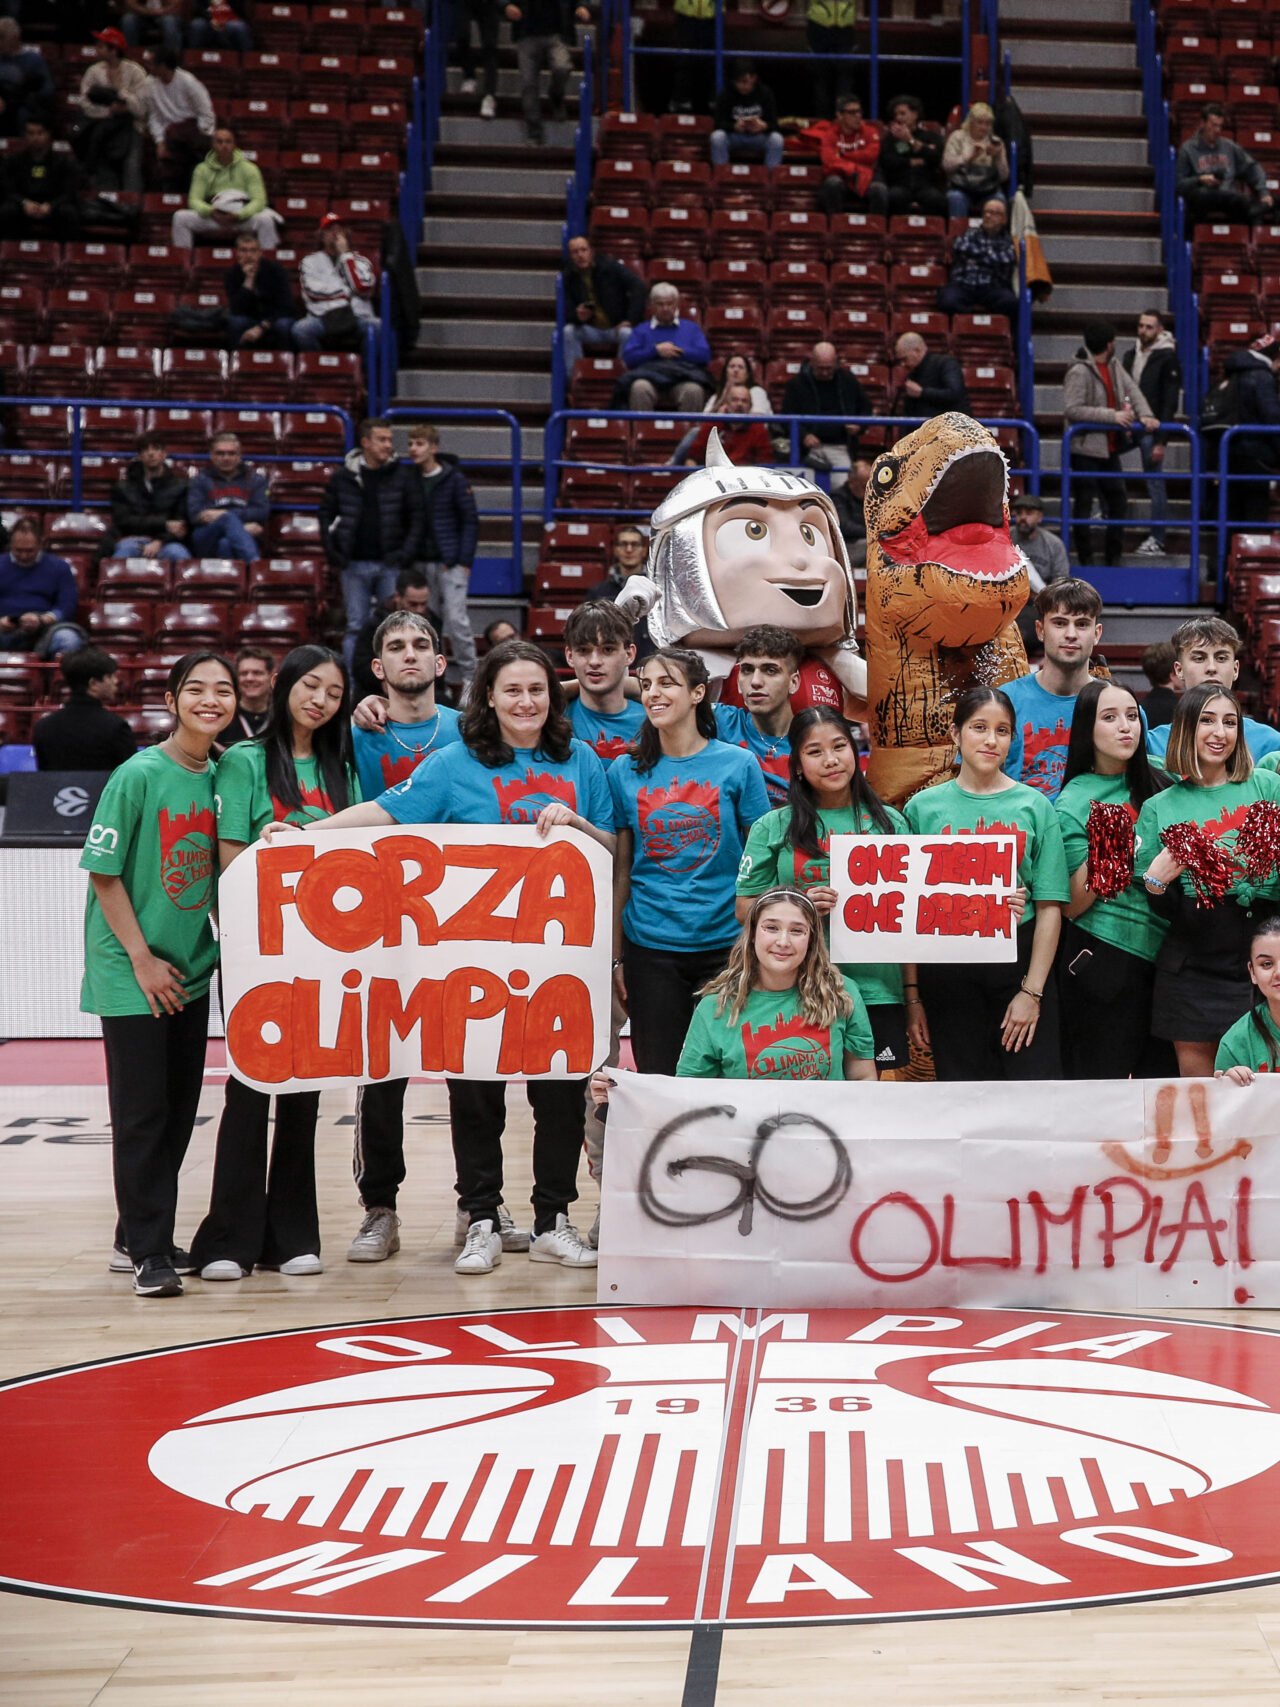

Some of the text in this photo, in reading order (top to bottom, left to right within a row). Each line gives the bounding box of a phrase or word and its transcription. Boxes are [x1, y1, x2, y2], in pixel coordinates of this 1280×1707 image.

[257, 835, 596, 955] FORZA
[847, 843, 910, 886] ONE
[921, 842, 1013, 887] TEAM
[843, 891, 1012, 939] ONE DREAM
[637, 1104, 853, 1236] GO
[315, 1313, 1173, 1363] OLIMPIA
[193, 1525, 1233, 1606] MILANO
